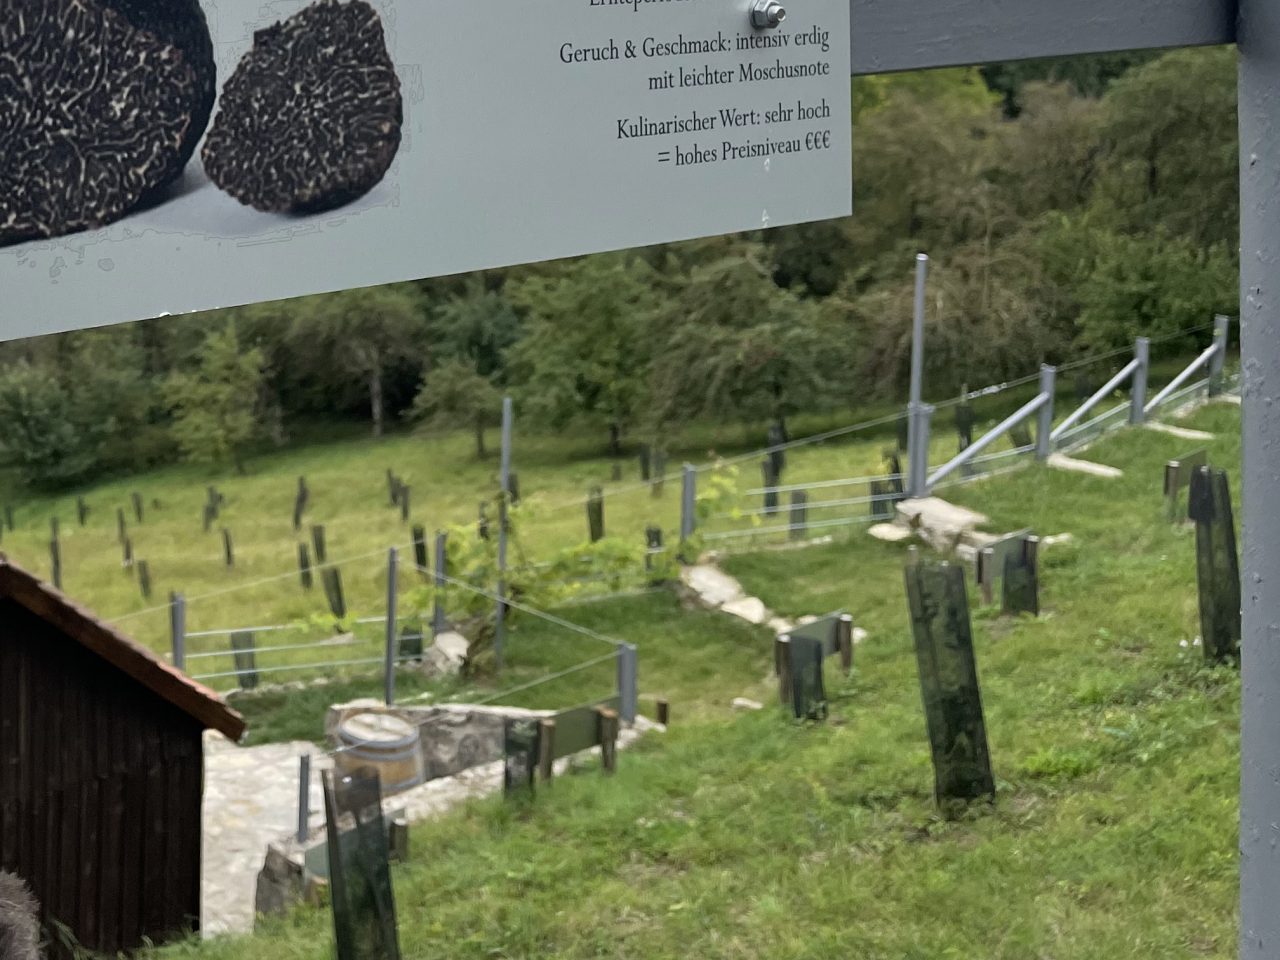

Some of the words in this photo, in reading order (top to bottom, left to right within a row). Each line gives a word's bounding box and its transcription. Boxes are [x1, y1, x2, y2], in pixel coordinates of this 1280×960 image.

[560, 39, 619, 63] Geruch
[625, 40, 637, 58] &
[643, 31, 731, 57] Geschmack:
[736, 30, 790, 48] intensiv
[795, 25, 829, 52] erdig
[648, 71, 675, 90] mit
[679, 65, 734, 87] leichter
[739, 59, 829, 82] Moschusnote
[617, 111, 717, 139] Kulinarischer
[718, 108, 760, 127] Wert:
[765, 102, 793, 123] sehr
[798, 98, 830, 120] hoch
[675, 143, 717, 166] hohes
[722, 138, 800, 160] Preisniveau
[805, 130, 830, 151] €€€
